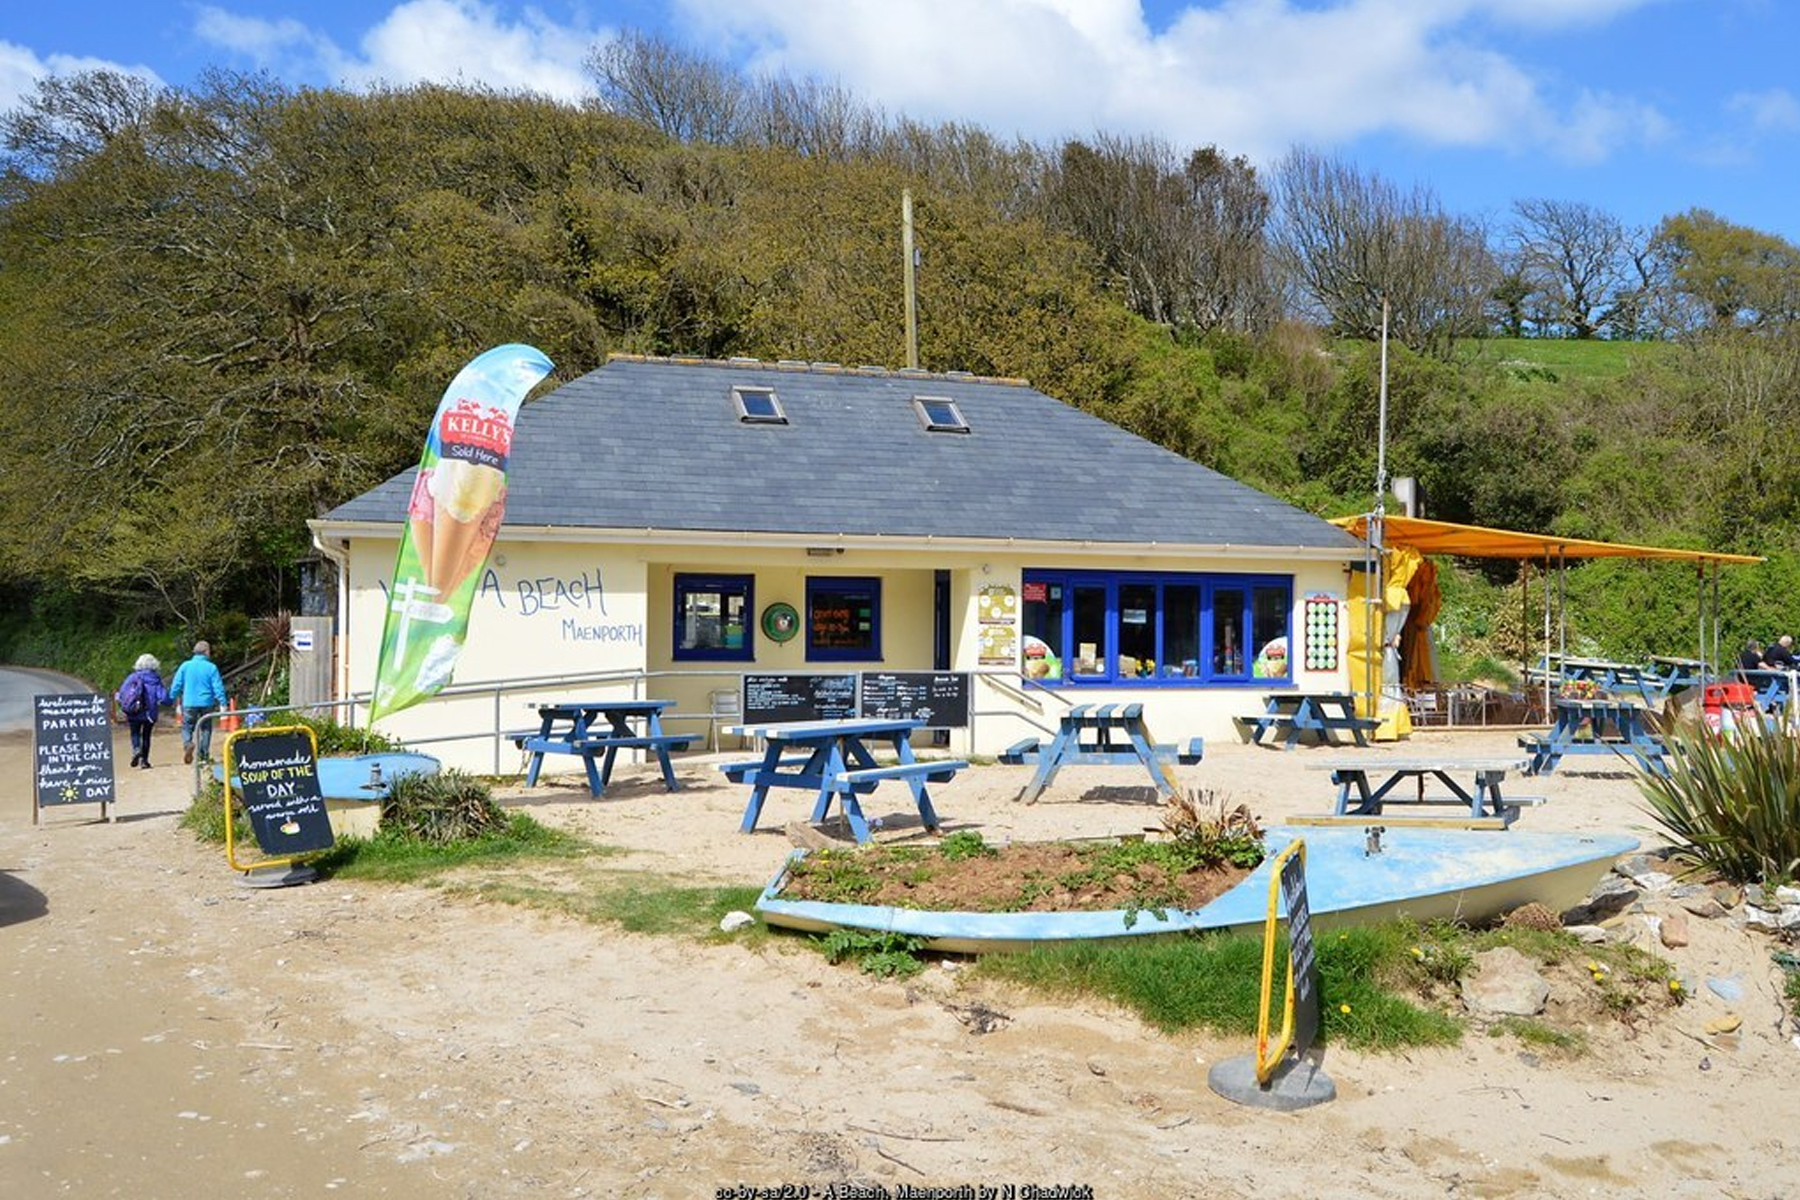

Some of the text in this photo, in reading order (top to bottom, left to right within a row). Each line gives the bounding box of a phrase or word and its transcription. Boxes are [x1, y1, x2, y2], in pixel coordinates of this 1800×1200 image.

[451, 445, 499, 465] Sold Here
[481, 567, 607, 617] A BEACH
[38, 694, 106, 707] welcome to
[43, 717, 107, 730] PARKING
[39, 741, 104, 756] PLEASE PAY
[48, 755, 59, 764] IN
[60, 753, 81, 763] THE
[239, 750, 312, 769] homemade
[38, 763, 73, 776] thank
[241, 765, 314, 785] SOUP OF THE
[38, 776, 70, 789] have
[84, 774, 113, 786] nice
[86, 785, 111, 798] DAY
[266, 782, 295, 798] DAY
